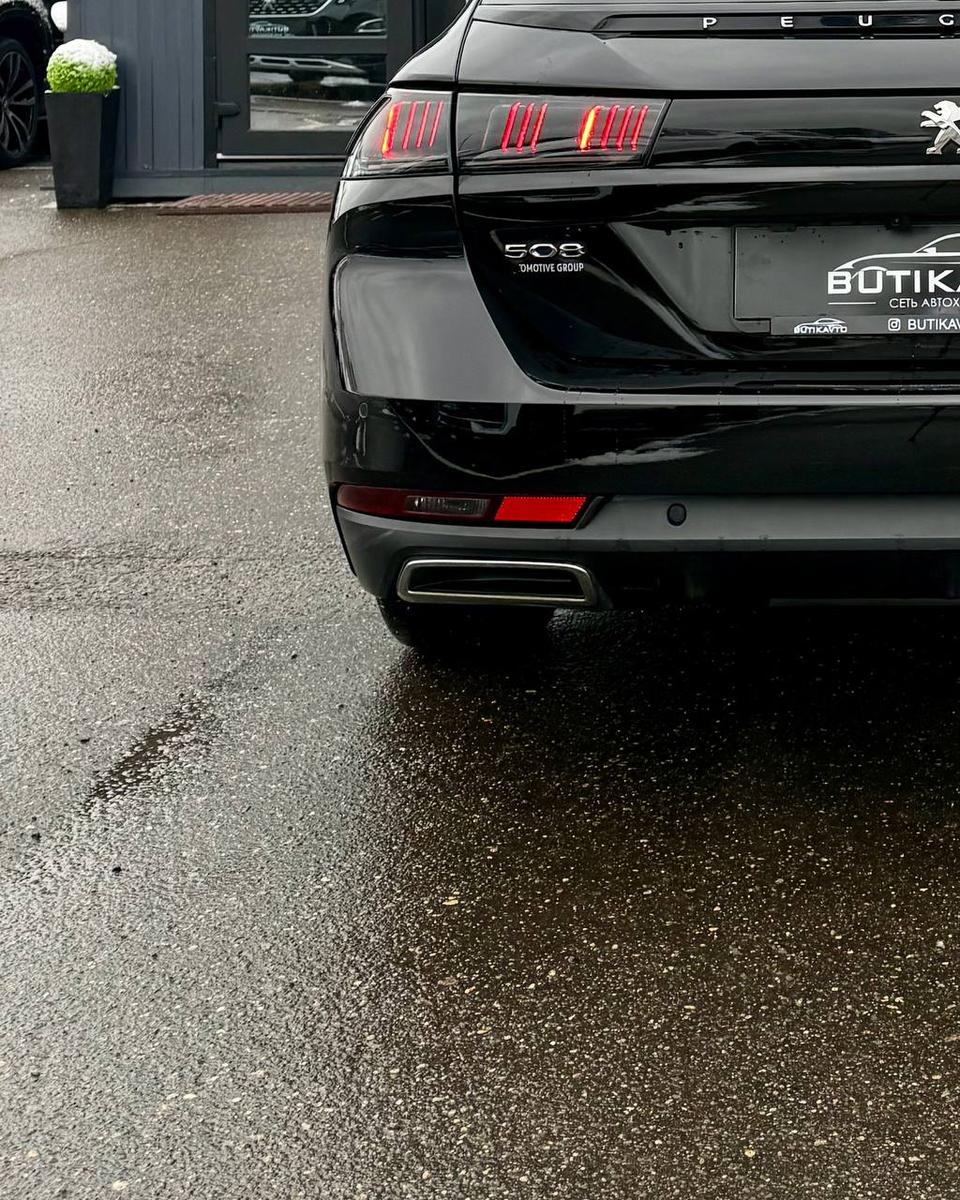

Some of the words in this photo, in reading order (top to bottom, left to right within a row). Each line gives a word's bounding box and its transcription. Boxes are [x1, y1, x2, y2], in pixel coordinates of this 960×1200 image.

[504, 243, 585, 258] 508
[519, 263, 556, 272] OMOTIVE
[556, 262, 584, 272] GROUP
[889, 298, 918, 309] СЕТЬ
